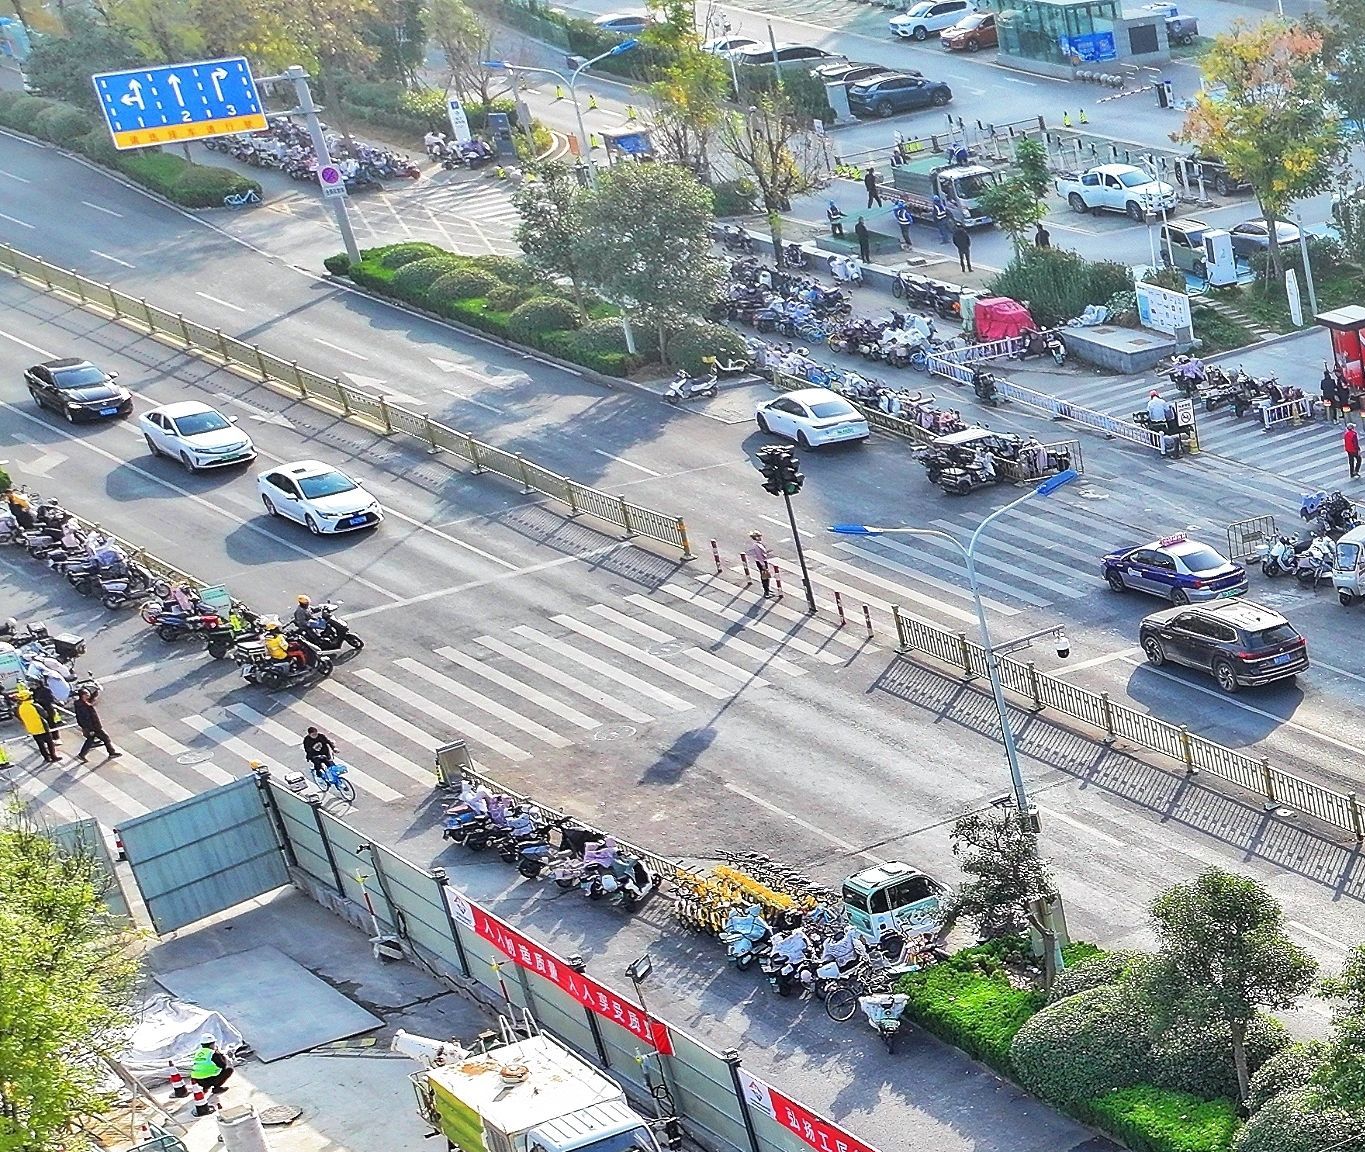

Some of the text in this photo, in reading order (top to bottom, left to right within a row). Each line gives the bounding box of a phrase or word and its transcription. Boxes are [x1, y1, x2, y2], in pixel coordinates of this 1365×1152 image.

[181, 110, 193, 122] 2
[226, 104, 237, 115] 3
[484, 918, 560, 983] 人人创造质量
